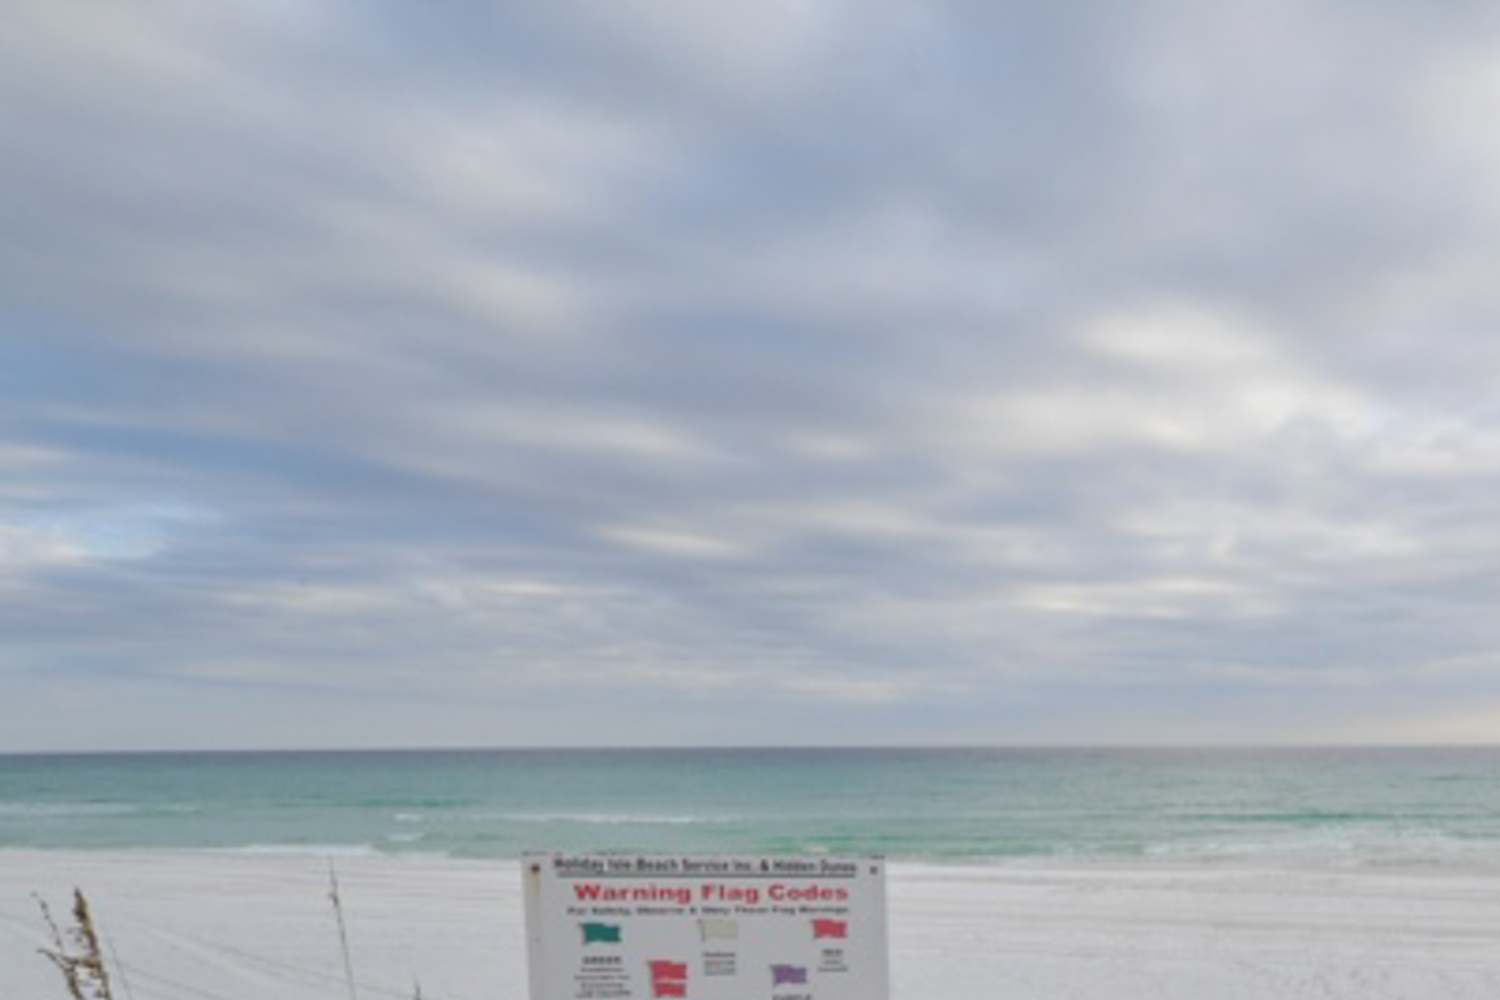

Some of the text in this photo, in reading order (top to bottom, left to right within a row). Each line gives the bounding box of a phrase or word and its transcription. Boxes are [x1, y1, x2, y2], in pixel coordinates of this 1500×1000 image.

[554, 858, 604, 875] Holiday
[607, 860, 632, 872] Isle
[636, 859, 679, 872] Beach
[682, 858, 729, 872] Service
[761, 858, 770, 872] &
[773, 859, 815, 872] Hidden
[573, 883, 848, 904] Warning Flag Codes
